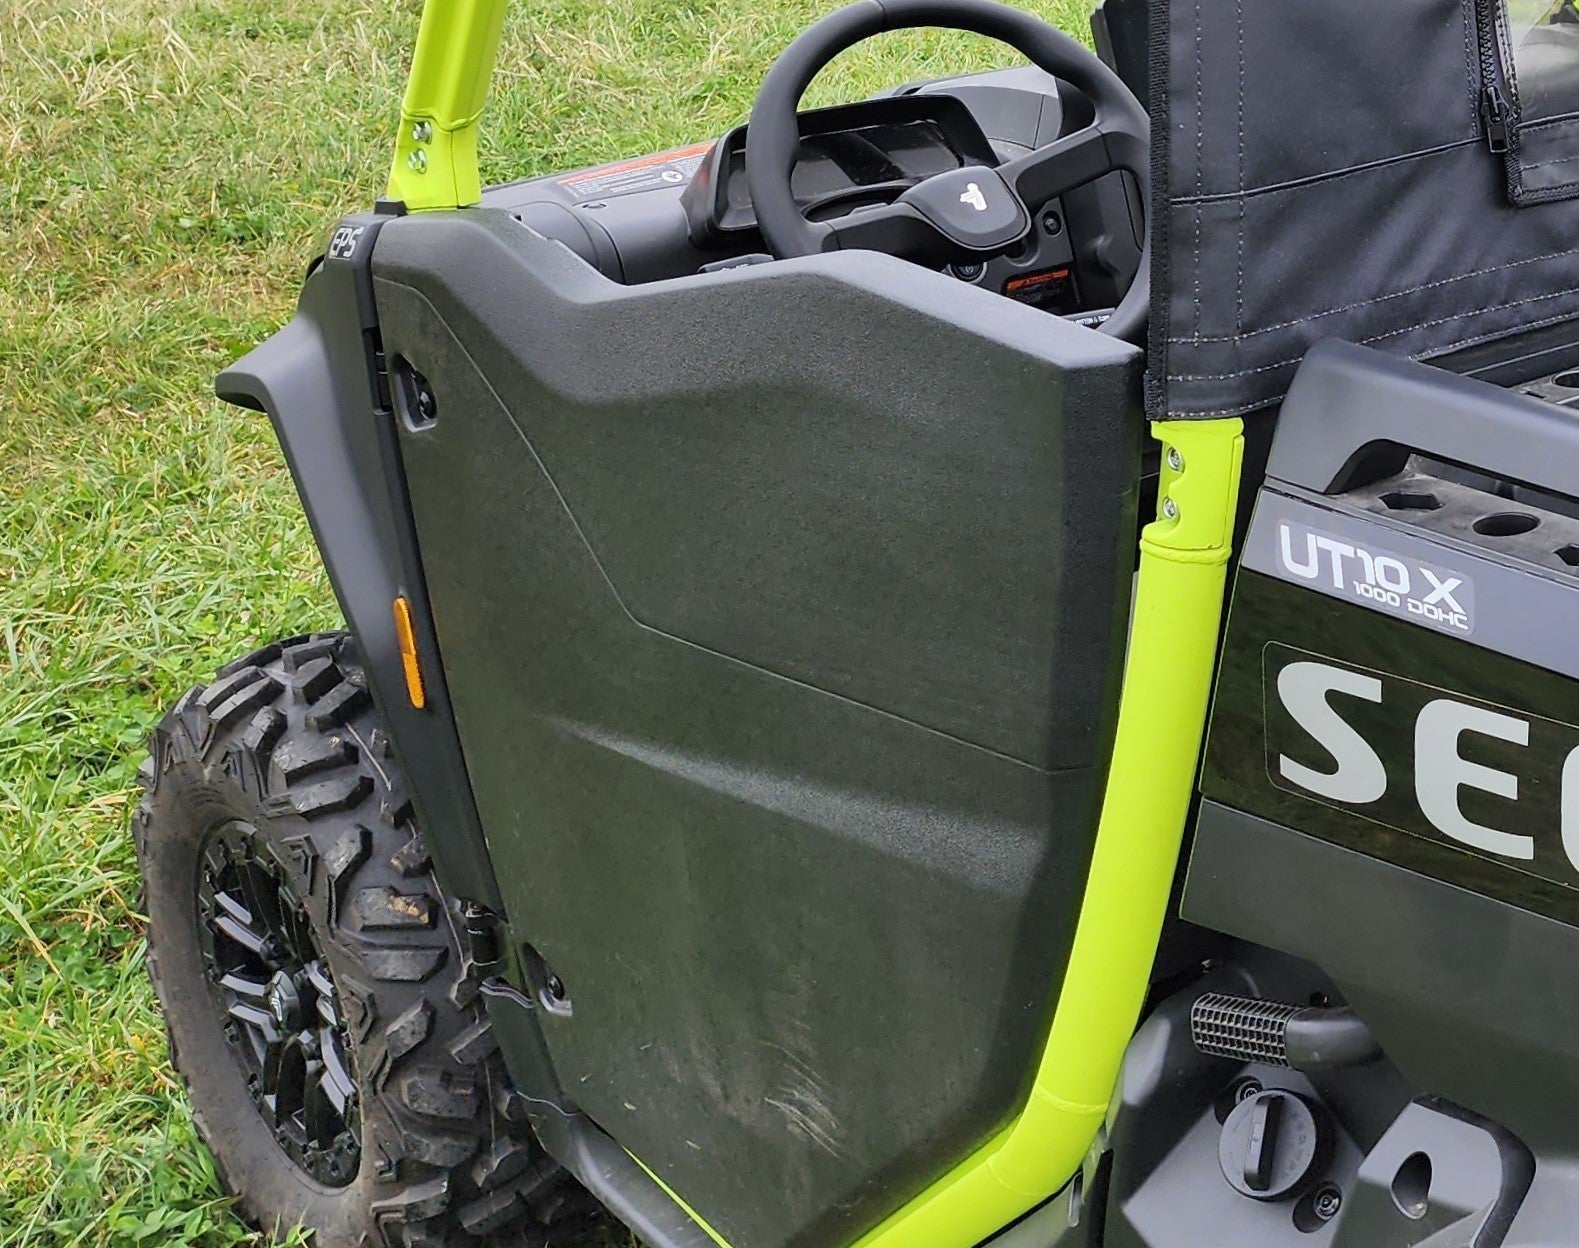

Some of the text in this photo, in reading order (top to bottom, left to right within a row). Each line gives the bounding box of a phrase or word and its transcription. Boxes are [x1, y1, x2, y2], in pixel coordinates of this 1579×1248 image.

[330, 226, 364, 257] EPS
[1280, 525, 1466, 614] UT10 X
[1354, 581, 1468, 629] 1000 DOHC
